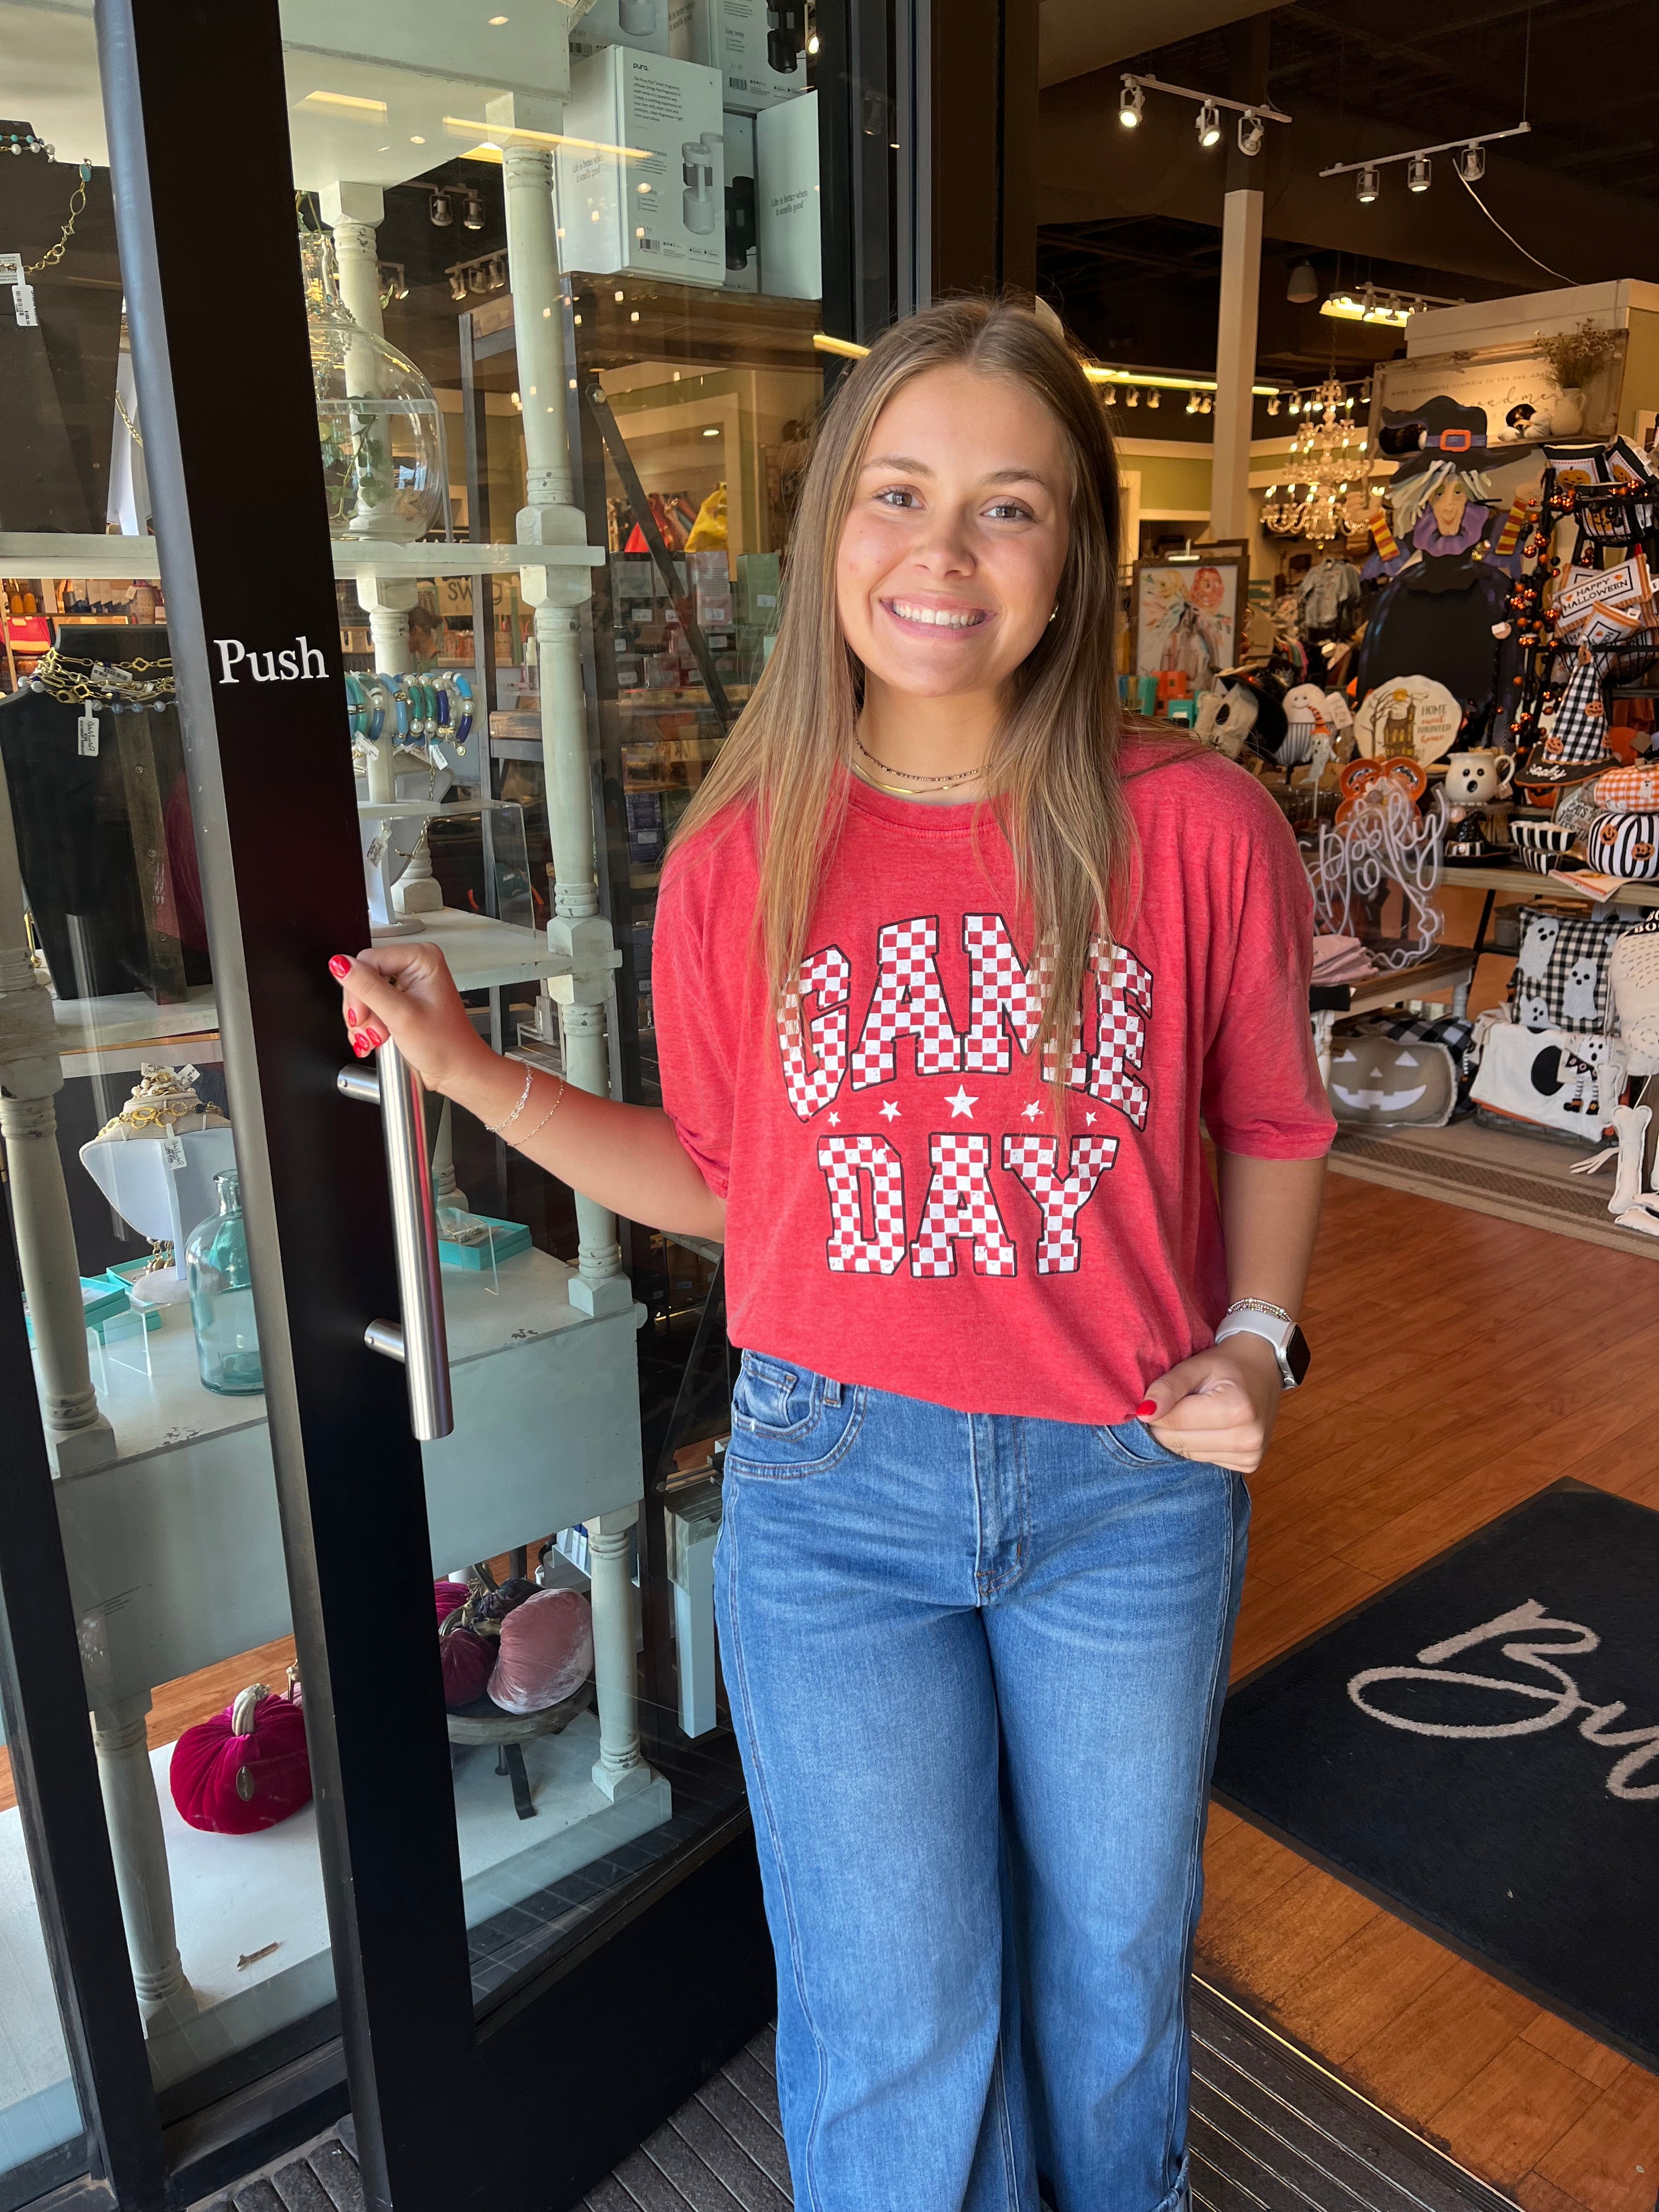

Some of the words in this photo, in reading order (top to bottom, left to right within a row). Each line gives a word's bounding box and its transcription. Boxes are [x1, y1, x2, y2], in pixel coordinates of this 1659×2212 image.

[1564, 579, 1628, 611] HALLOWEEN
[1576, 578, 1610, 597] HAPPY
[213, 636, 329, 684] Push
[1421, 704, 1447, 716] HOME
[776, 912, 1153, 1132] GAME
[817, 1132, 1120, 1278] DAY
